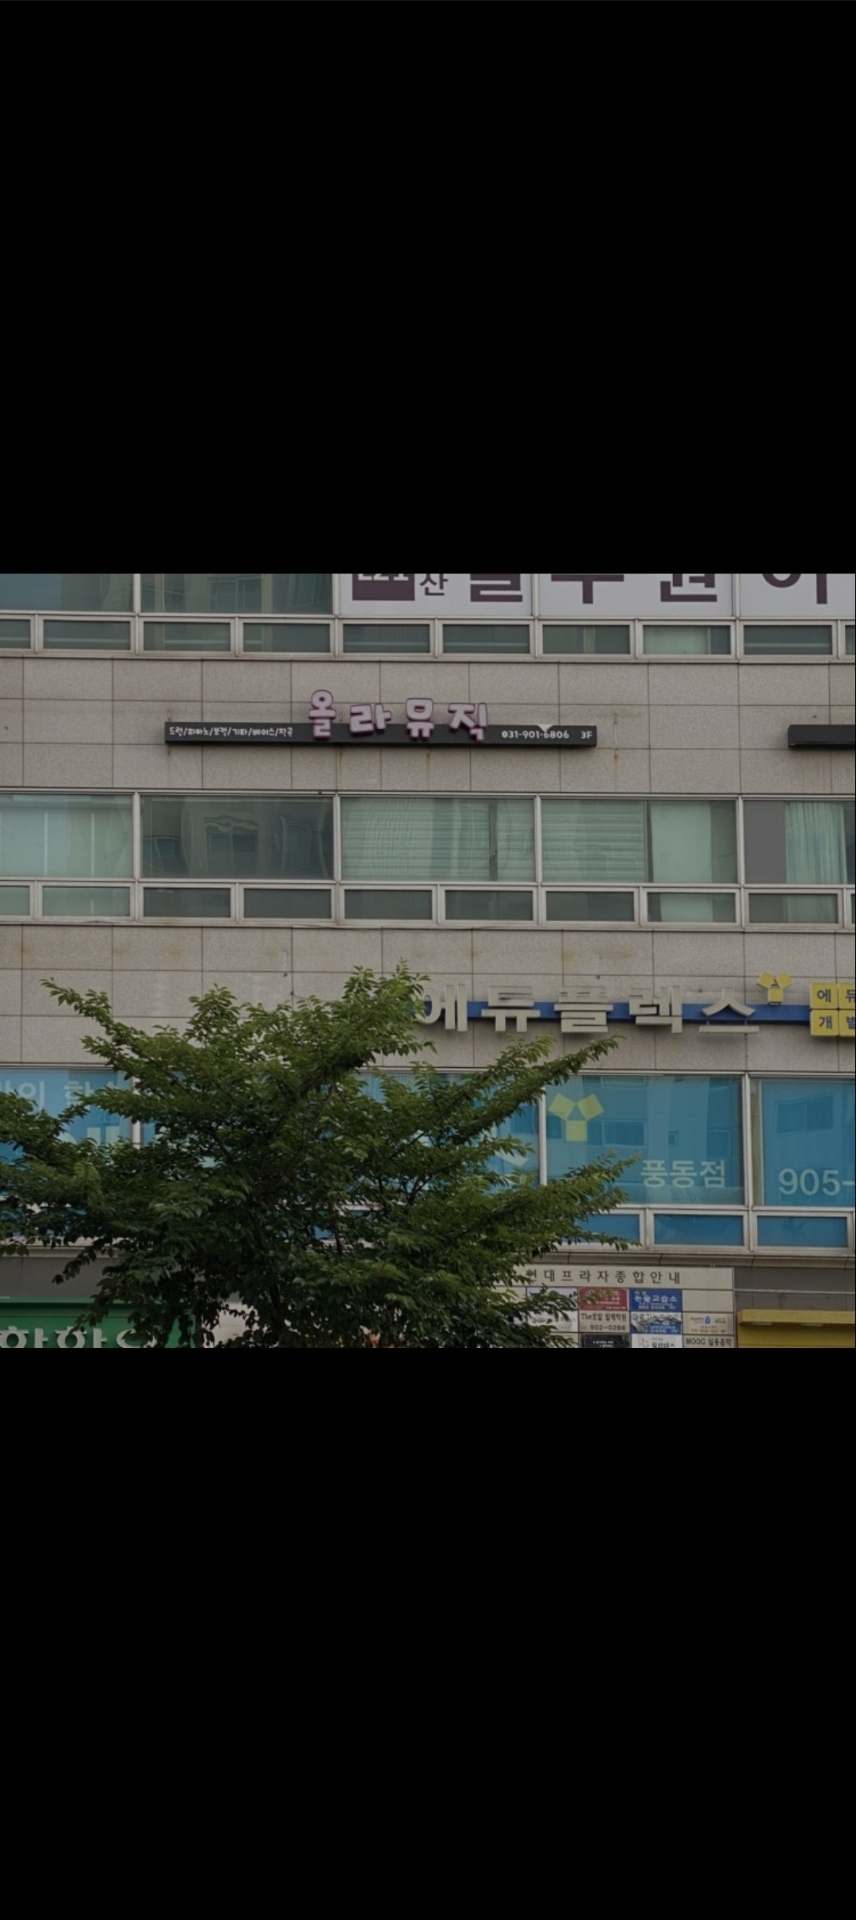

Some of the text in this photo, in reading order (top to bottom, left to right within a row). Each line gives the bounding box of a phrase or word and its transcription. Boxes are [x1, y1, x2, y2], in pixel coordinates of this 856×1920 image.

[308, 689, 488, 743] 올라뮤직
[501, 730, 593, 740] 031-901-6806 3F
[420, 983, 760, 1034] 에듀플렉스
[640, 1159, 726, 1189] 풍동점
